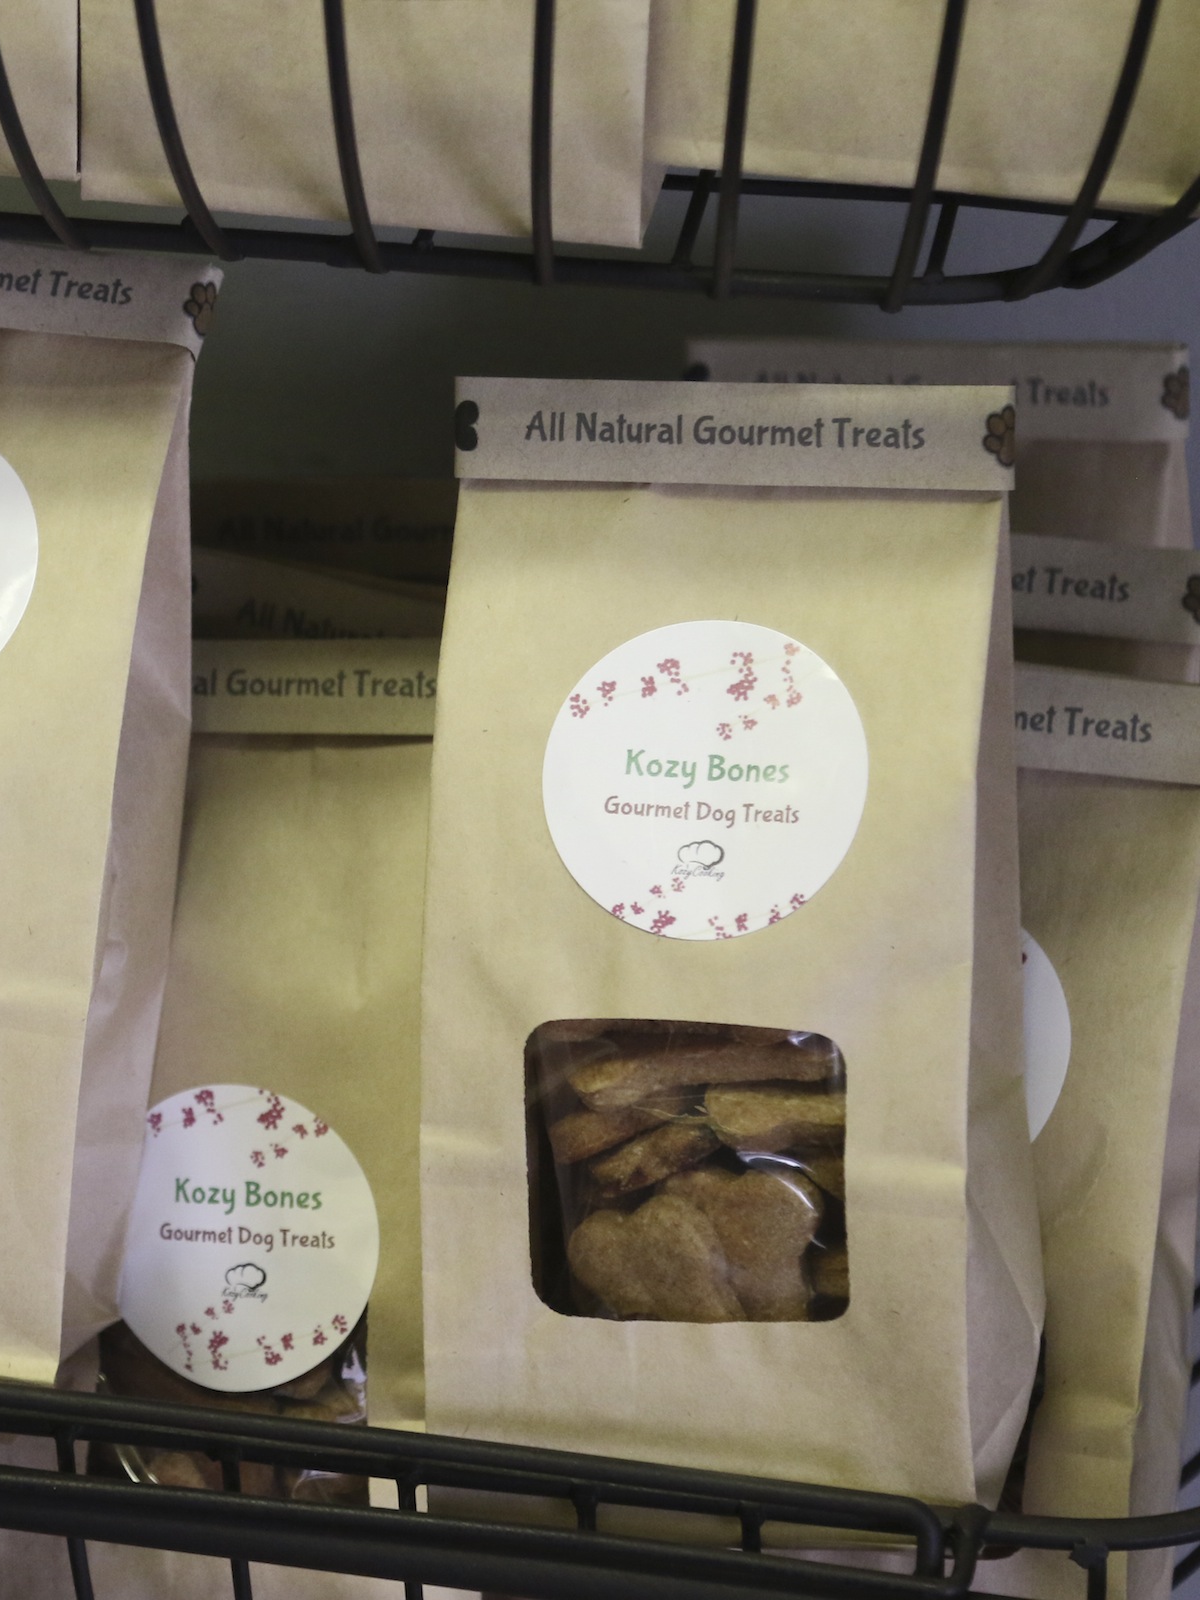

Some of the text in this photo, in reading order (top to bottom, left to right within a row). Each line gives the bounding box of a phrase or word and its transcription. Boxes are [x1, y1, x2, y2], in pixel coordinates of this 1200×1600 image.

[49, 269, 134, 306] Treats
[1025, 377, 1110, 408] Treats
[524, 410, 927, 450] All Natural Gourmet Treats
[1044, 566, 1131, 602] Treats
[225, 668, 347, 698] Gourmet
[353, 669, 438, 699] Treats
[1064, 706, 1153, 744] Treats
[624, 748, 791, 790] Kozy Bones
[603, 795, 801, 829] Gourmet Dog Treats
[174, 1177, 324, 1215] Kozy Bones
[159, 1222, 336, 1252] Gourmet Dog Treats
